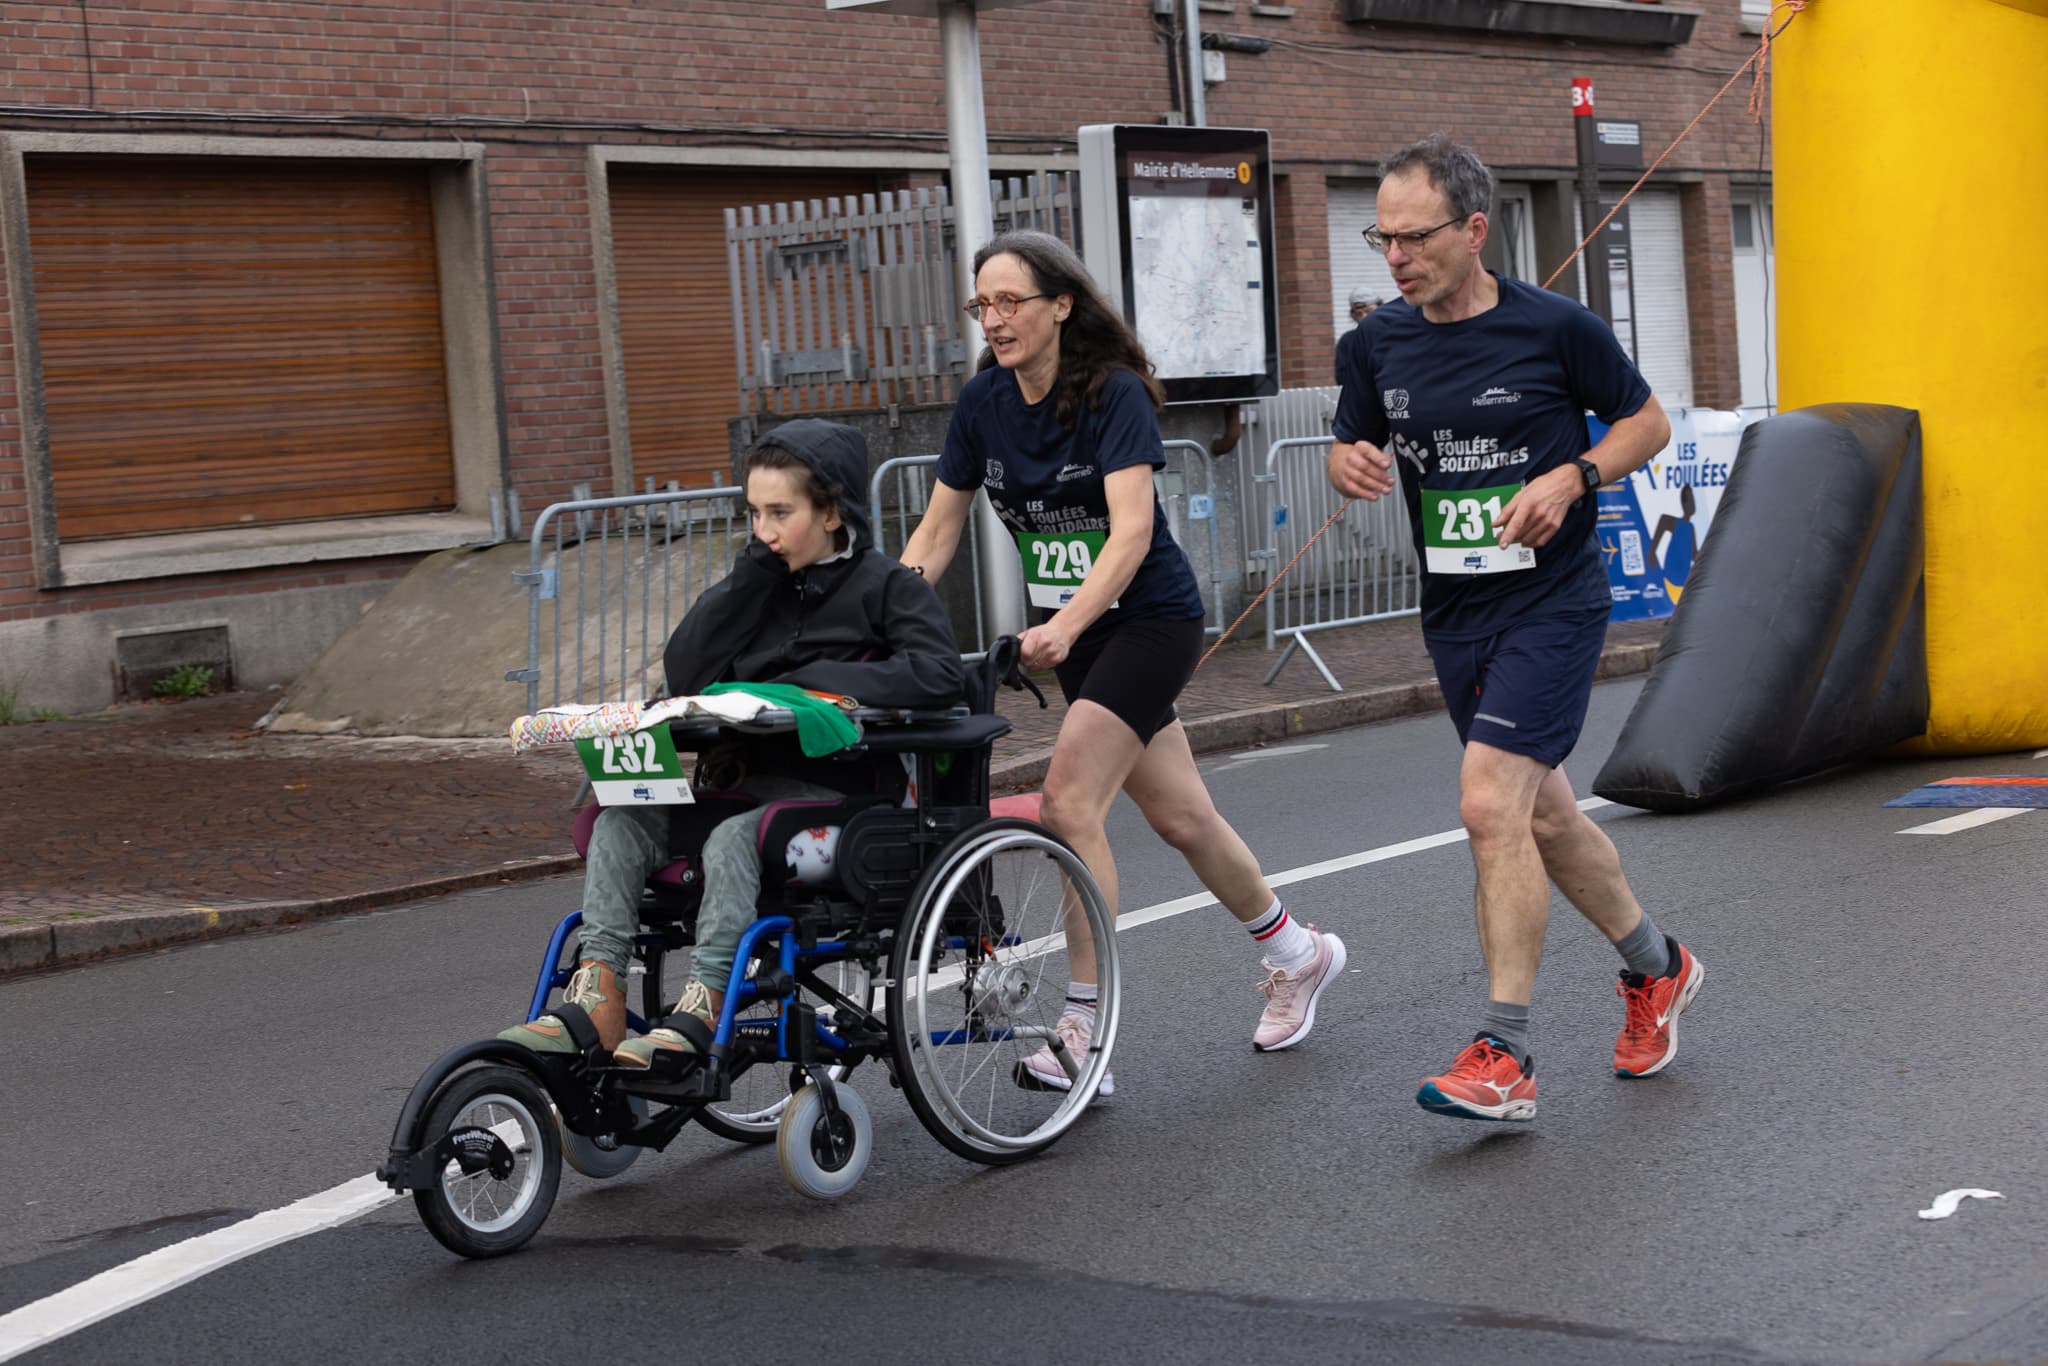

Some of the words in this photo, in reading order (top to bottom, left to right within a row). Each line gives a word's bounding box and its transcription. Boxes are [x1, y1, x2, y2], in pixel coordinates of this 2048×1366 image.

[1134, 162, 1169, 178] Mairie
[1170, 162, 1237, 179] d'Hellemmes
[1433, 430, 1453, 441] LES
[1436, 435, 1499, 457] FOULÉES
[1677, 443, 1697, 461] LES
[1439, 446, 1529, 473] SOLIDAIRES
[1665, 457, 1728, 489] FOULÉES
[1026, 500, 1044, 512] LES
[1030, 506, 1087, 524] FOULÉES
[1438, 496, 1503, 542] 231
[1032, 540, 1092, 579] 229
[594, 732, 664, 774] 232
[452, 1130, 496, 1145] FreeWheel
